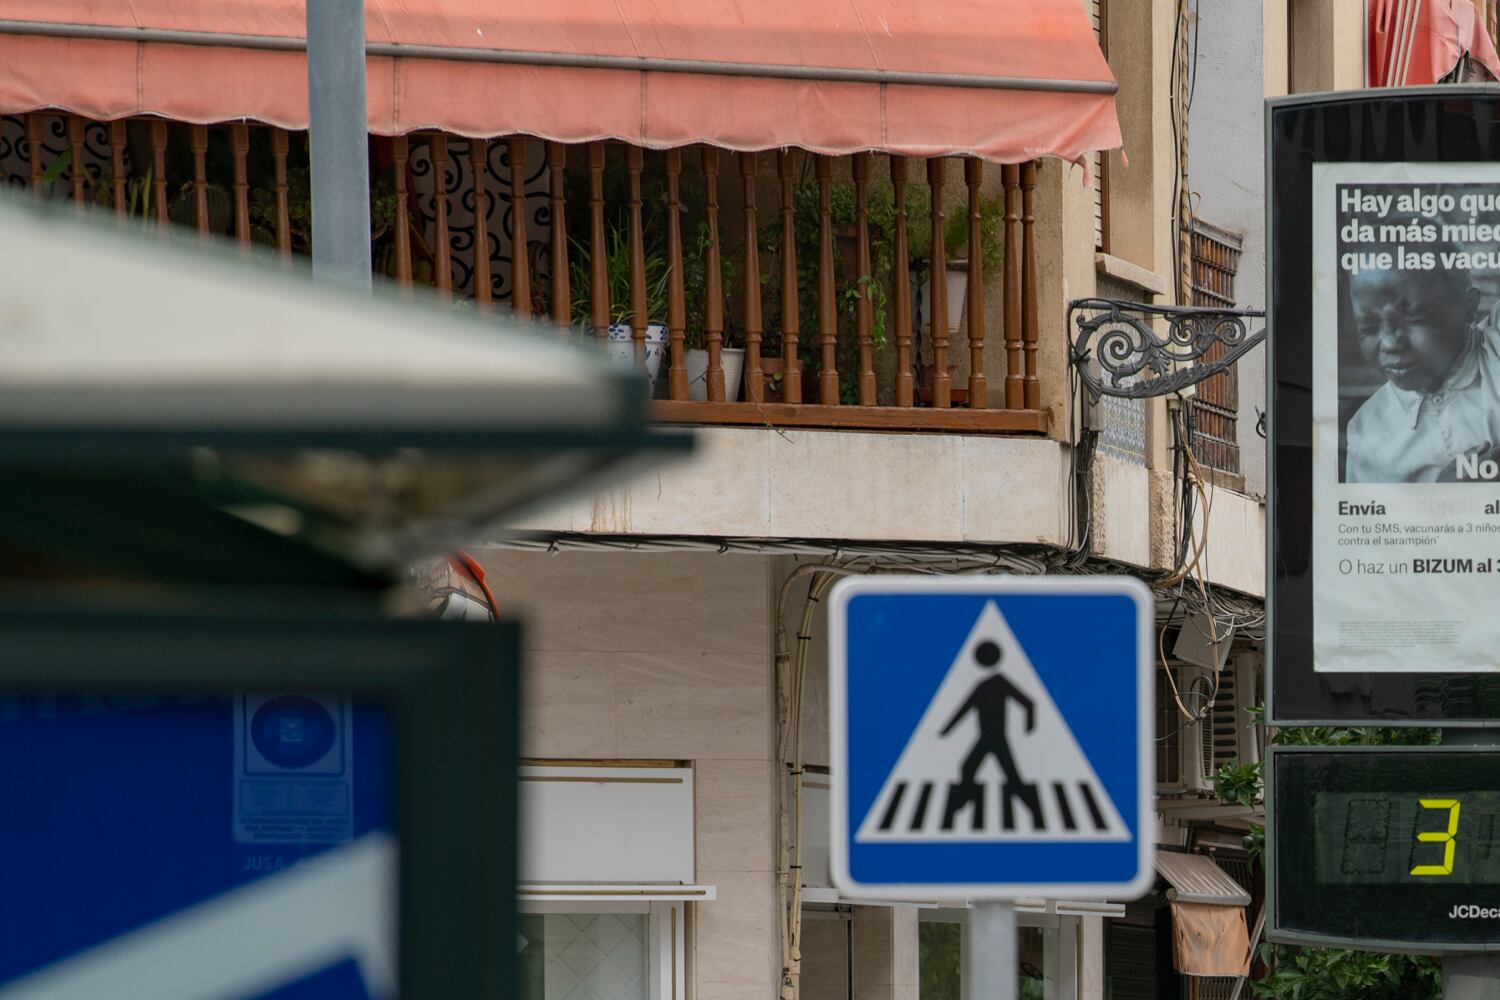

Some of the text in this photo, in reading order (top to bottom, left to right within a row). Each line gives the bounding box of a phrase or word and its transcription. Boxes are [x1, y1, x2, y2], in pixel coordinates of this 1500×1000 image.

[1341, 189, 1394, 218] Hay
[1397, 189, 1455, 218] algo
[1341, 218, 1375, 243] da
[1379, 218, 1437, 243] más
[1341, 250, 1393, 276] que
[1398, 246, 1436, 271] las
[1455, 454, 1498, 480] No
[1338, 500, 1386, 516] Envía
[1484, 500, 1500, 515] al
[1338, 524, 1359, 534] Con
[1361, 525, 1372, 534] tu
[1375, 523, 1402, 535] SMS,
[1404, 523, 1455, 533] vacunarás
[1458, 525, 1464, 533] a
[1466, 523, 1473, 533] 3
[1338, 537, 1370, 546] contra
[1373, 536, 1381, 545] el
[1339, 559, 1353, 575] O
[1357, 559, 1384, 574] haz
[1389, 562, 1408, 574] un
[1413, 559, 1473, 574] BIZUM
[1476, 558, 1491, 573] al
